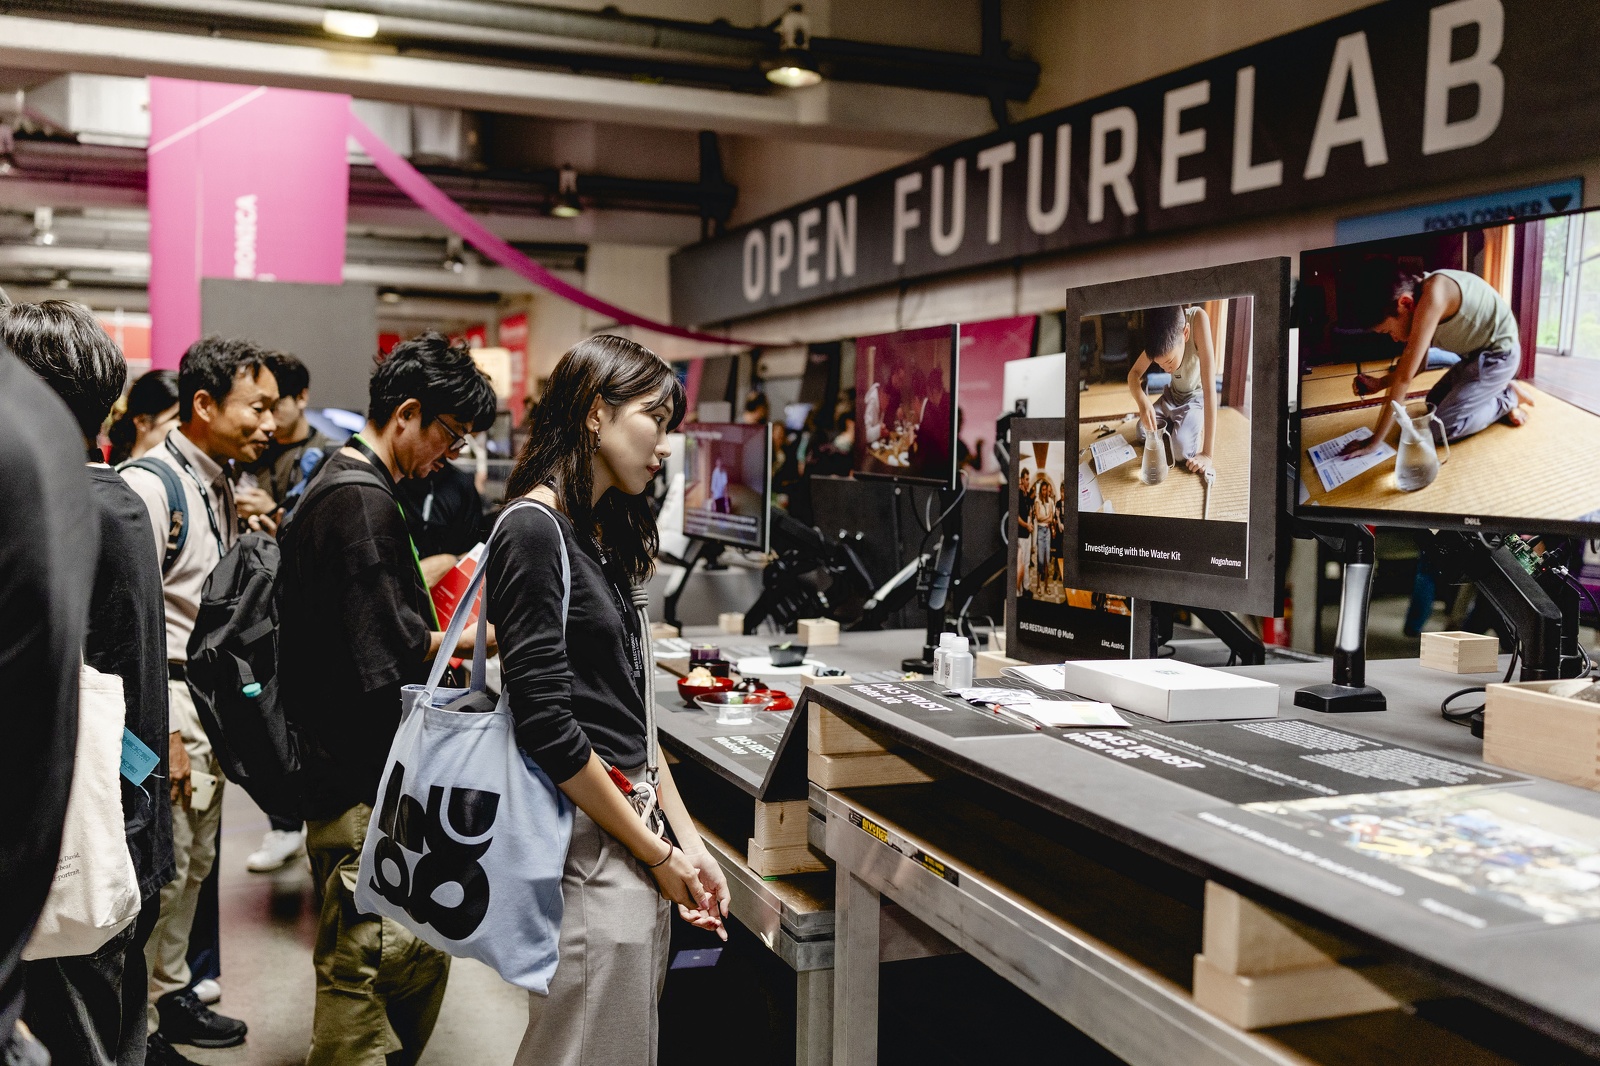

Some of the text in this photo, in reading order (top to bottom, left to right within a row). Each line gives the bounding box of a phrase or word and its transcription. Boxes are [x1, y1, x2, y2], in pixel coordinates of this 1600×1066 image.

[742, 0, 1505, 303] OPEN FUTURELAB
[1424, 210, 1468, 231] FOOD
[1464, 517, 1482, 526] DELL
[1085, 542, 1181, 561] Investigating with the Water Kit
[1210, 556, 1242, 567] Nagahama
[1020, 621, 1075, 640] DAS RESTAURANT @ Muto
[1101, 639, 1125, 650] Linz, Austria
[870, 683, 908, 695] DAS
[902, 693, 953, 712] TRUST
[729, 735, 757, 744] DAS
[1086, 731, 1137, 746] DAS
[1127, 744, 1206, 768] TRUST
